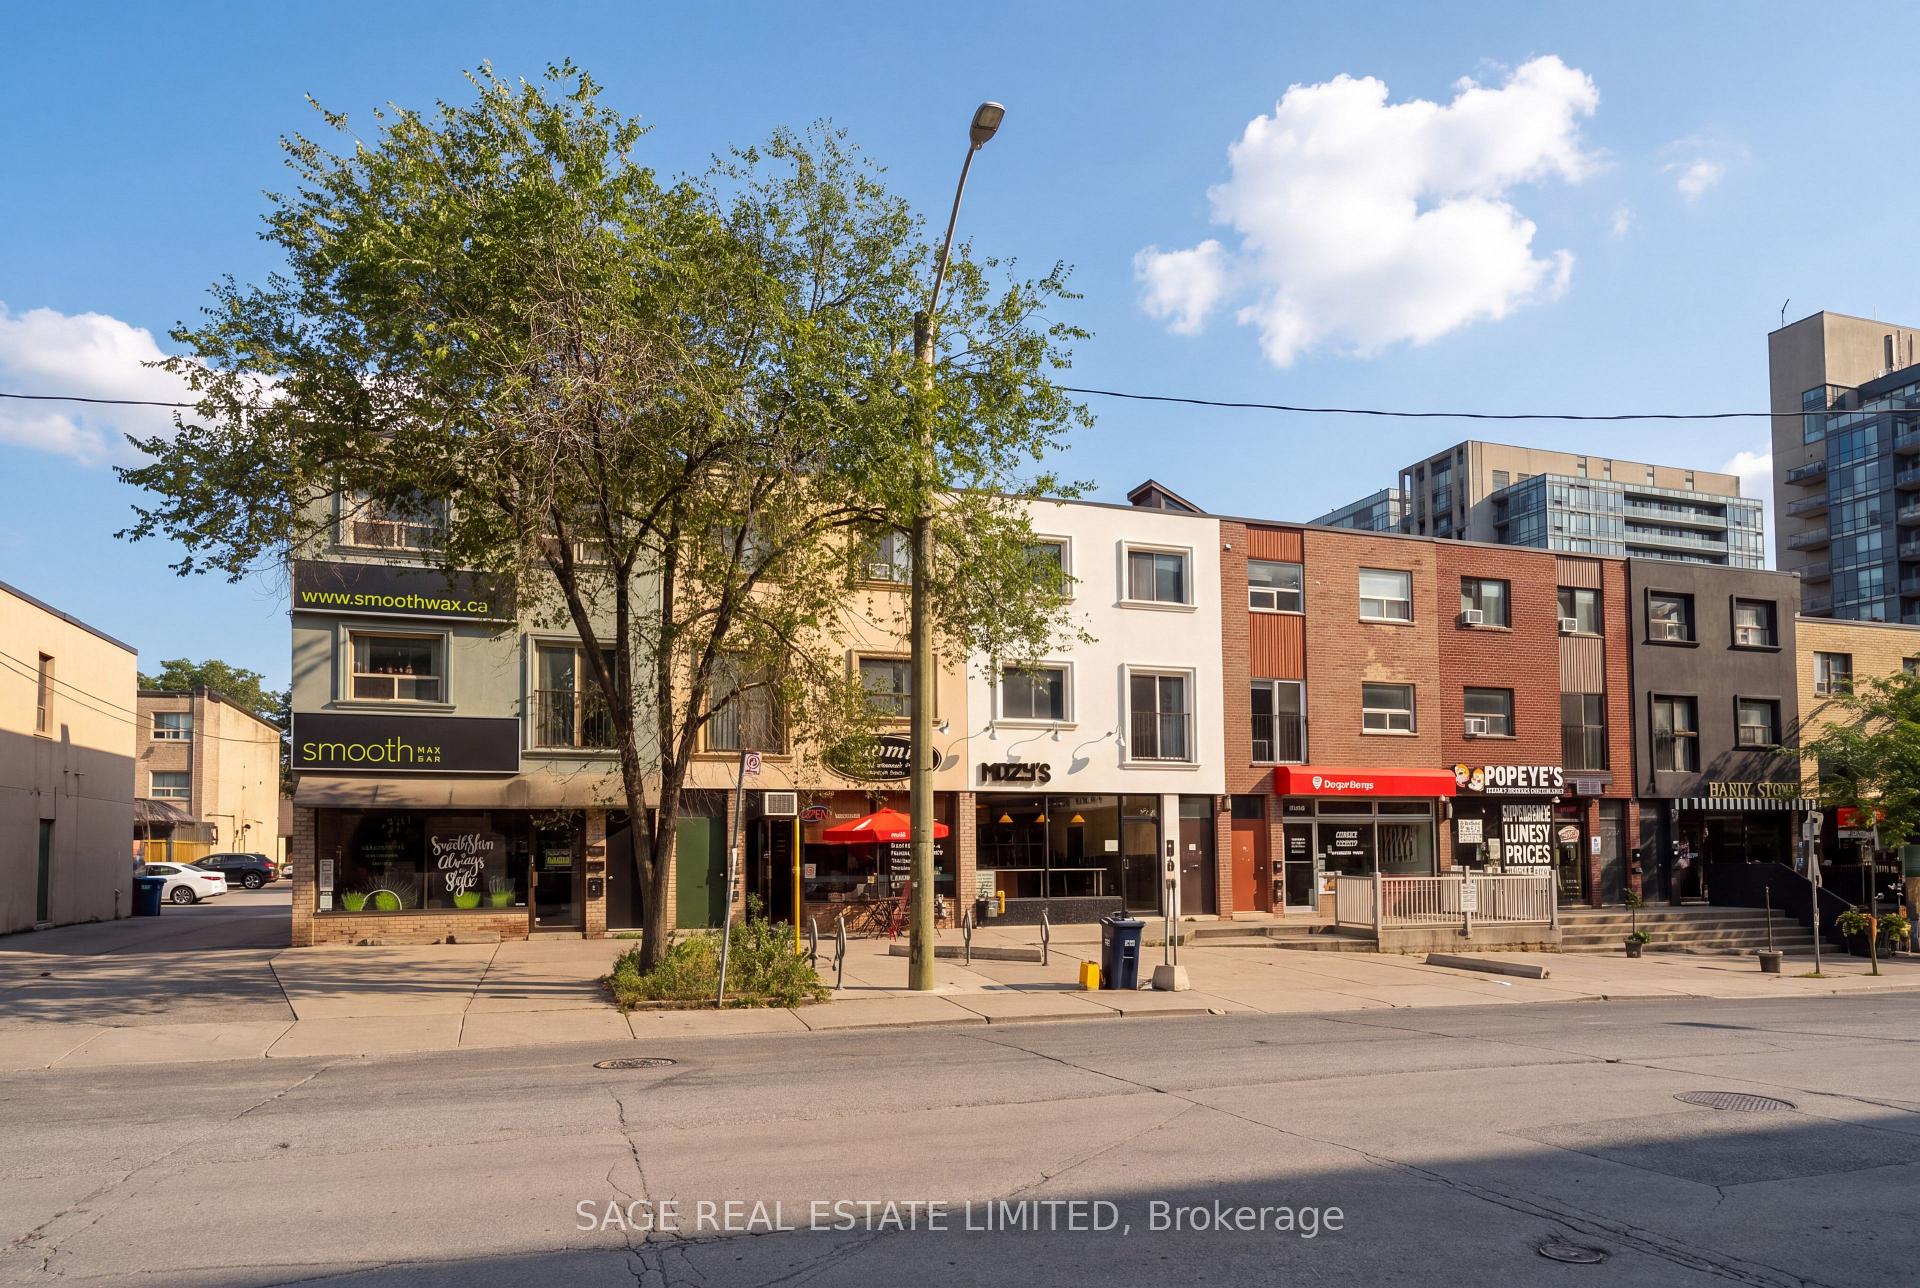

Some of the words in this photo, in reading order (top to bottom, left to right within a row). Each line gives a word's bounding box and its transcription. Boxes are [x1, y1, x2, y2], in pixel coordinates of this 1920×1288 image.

[302, 591, 488, 613] www.smoothwax.ca
[303, 736, 413, 763] smooth
[417, 746, 441, 754] MAX
[1484, 765, 1564, 788] POPEYE'S
[1504, 824, 1551, 843] LUNESY
[1505, 844, 1551, 864] PRICES
